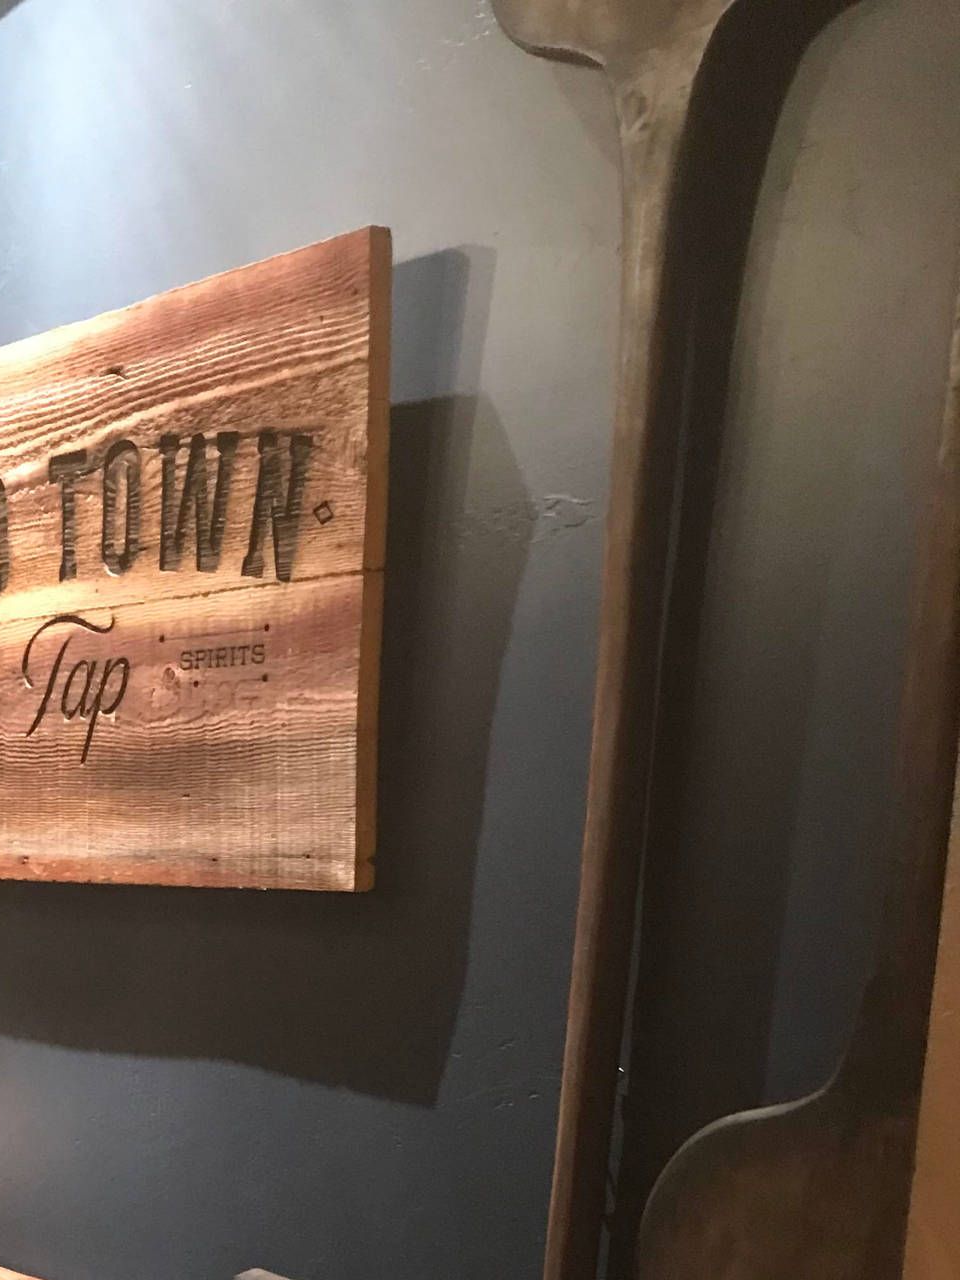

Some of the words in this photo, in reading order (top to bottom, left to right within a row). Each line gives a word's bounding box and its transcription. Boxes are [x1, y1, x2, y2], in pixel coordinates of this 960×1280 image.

[48, 430, 313, 583] TOWN
[21, 614, 131, 765] Tap
[179, 643, 266, 671] SPIRITS
